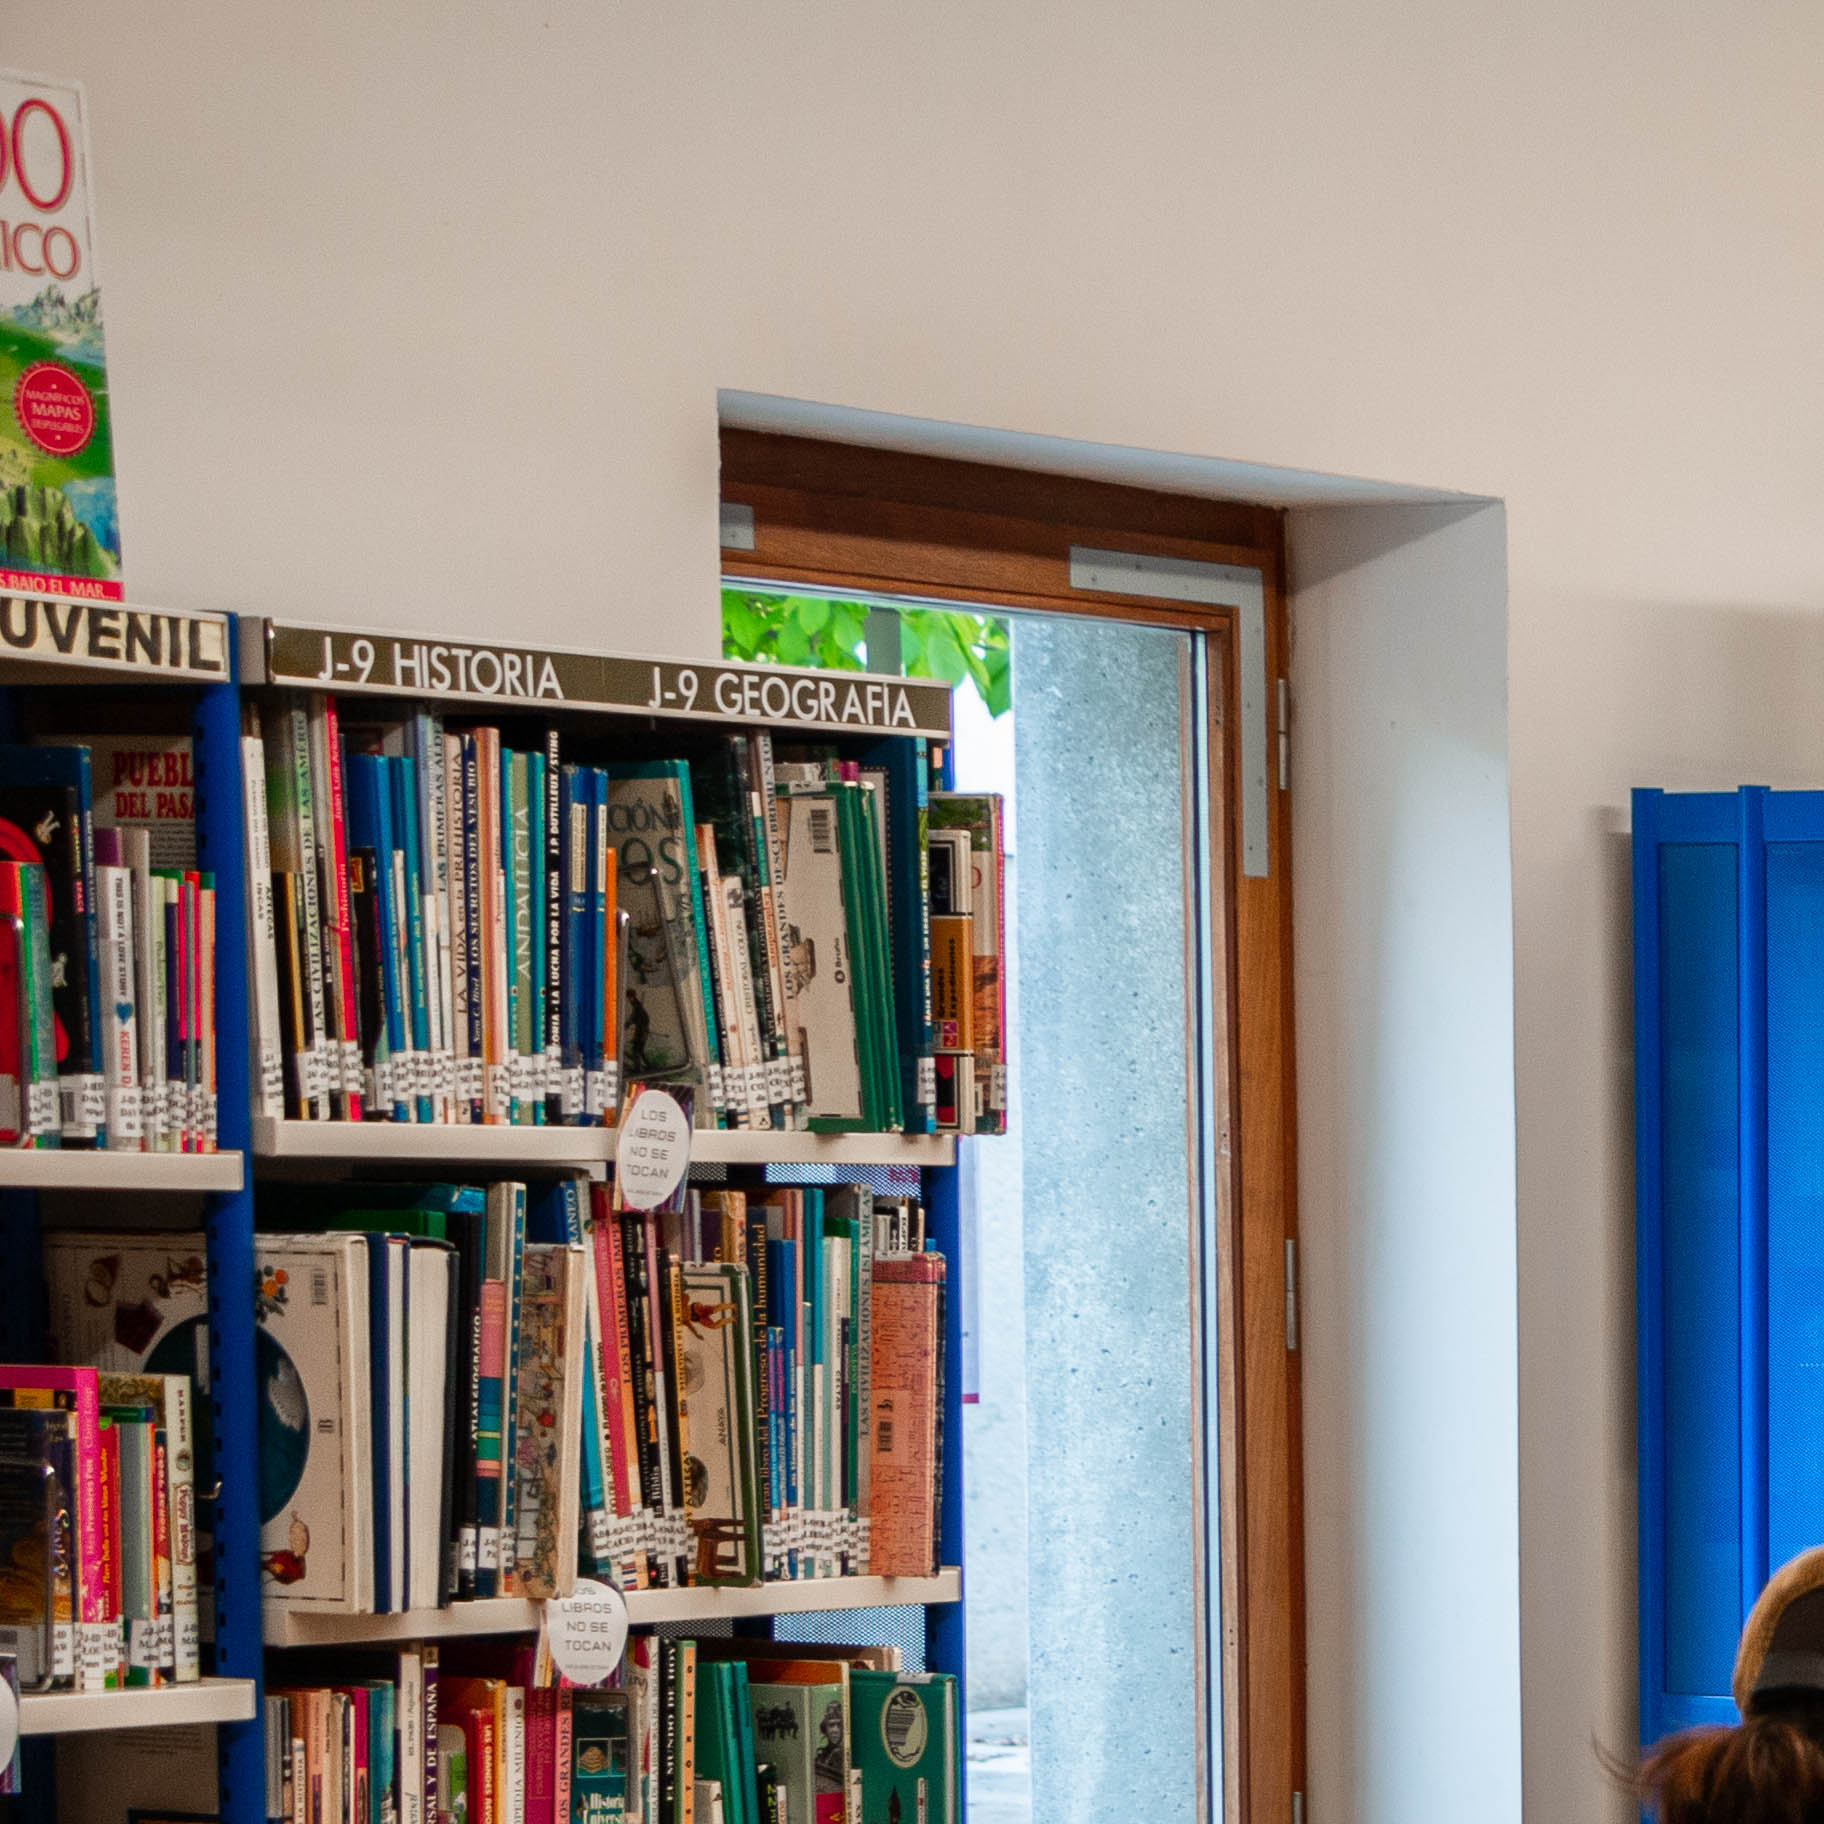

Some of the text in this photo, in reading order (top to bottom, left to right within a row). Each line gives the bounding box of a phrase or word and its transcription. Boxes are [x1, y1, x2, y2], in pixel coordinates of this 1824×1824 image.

[31, 402, 82, 421] MAPAS
[317, 636, 564, 699] J-9 HISTORIA
[648, 667, 916, 728] J-9 GEOGRAFÍA
[294, 716, 324, 1031] LAS CIVILIZACIONES DE LAS AMÉRIC
[760, 736, 795, 1001] LOS GRANDES DESCUBRIMIENTOS
[549, 871, 560, 896] VIDA
[549, 899, 560, 915] LA
[550, 919, 560, 945] POR
[453, 929, 466, 978] VIDA
[550, 948, 560, 986] LUCHA
[457, 989, 468, 1014] LA
[550, 990, 560, 1005] LA
[641, 1111, 667, 1122] LOS
[630, 1129, 677, 1142] LIBROS
[631, 1148, 669, 1160] NO SE
[627, 1165, 669, 1178] TOCAN
[611, 1210, 626, 1263] IMPE
[752, 1224, 766, 1308] humanidad
[614, 1267, 629, 1354] PRIMEROS
[754, 1313, 767, 1326] la
[755, 1330, 767, 1349] de
[860, 1278, 871, 1401] CIVILIZACIONES
[757, 1353, 769, 1418] Progreso
[860, 1407, 870, 1436] LAS
[758, 1426, 769, 1444] del
[759, 1448, 770, 1478] libro
[561, 1603, 612, 1614] LIBROS
[566, 1622, 609, 1633] NO SE
[565, 1641, 611, 1651] TOCAN
[425, 1682, 438, 1739] ESPAÑA
[666, 1647, 677, 1801] EL MUNDO DE HOY
[427, 1747, 437, 1767] DE
[557, 1717, 570, 1793] GRANDES
[427, 1776, 437, 1785] Y
